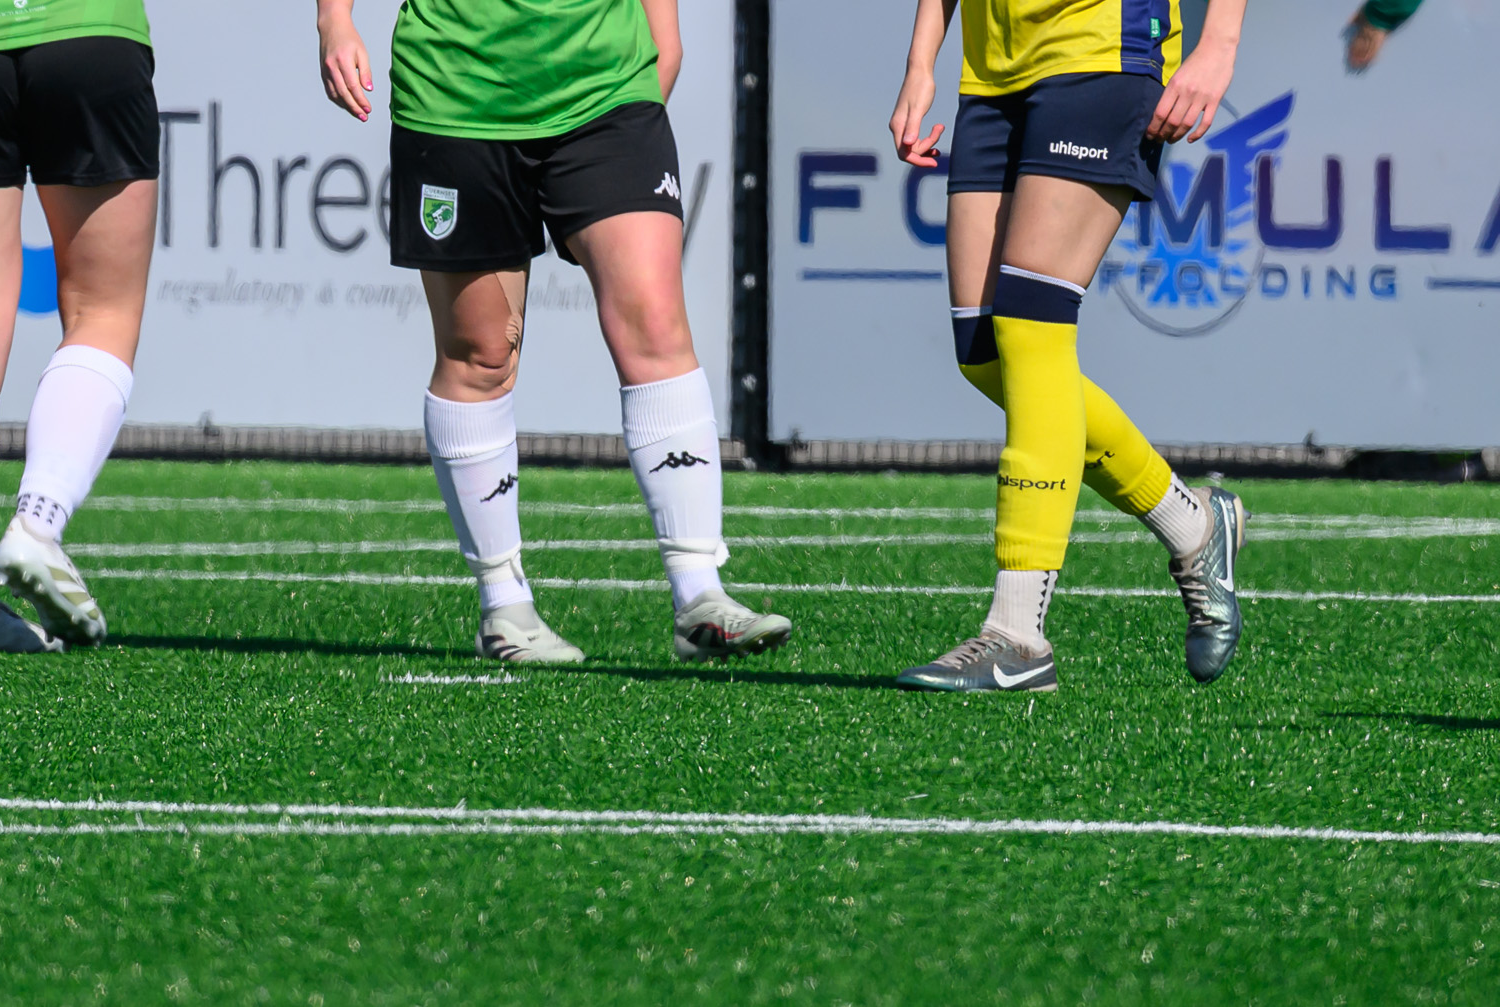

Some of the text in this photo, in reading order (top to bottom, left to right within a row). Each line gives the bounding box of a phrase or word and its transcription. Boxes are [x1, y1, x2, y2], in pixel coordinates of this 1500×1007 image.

[1049, 140, 1109, 160] uhlsport
[157, 98, 392, 254] Thre
[799, 152, 1500, 254] FMUL
[1098, 260, 1398, 299] FFOLDING
[998, 473, 1067, 490] hlsport
